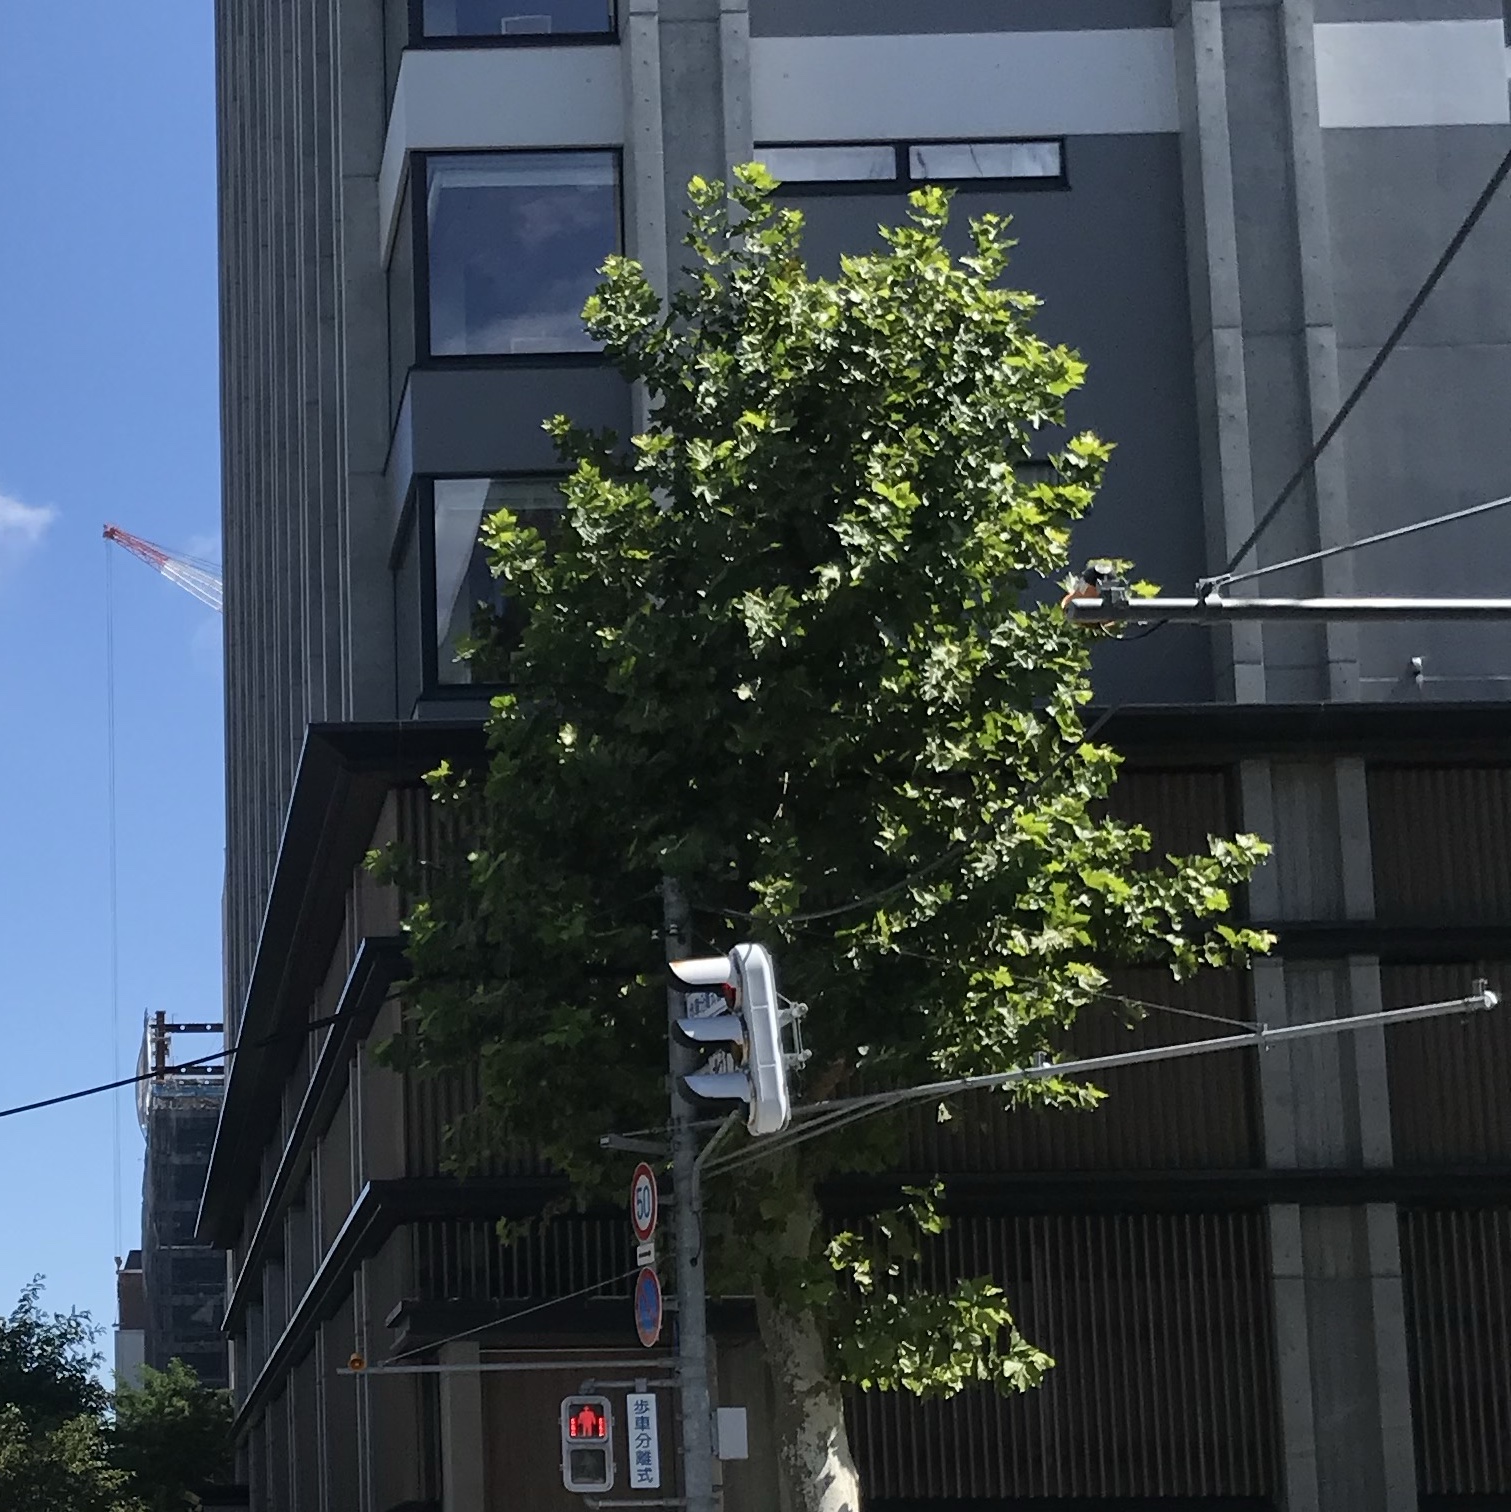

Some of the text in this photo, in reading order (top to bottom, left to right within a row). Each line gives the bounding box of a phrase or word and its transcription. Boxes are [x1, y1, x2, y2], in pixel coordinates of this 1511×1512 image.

[637, 1185, 650, 1220] 50
[634, 1399, 653, 1484] 歩車分離式
